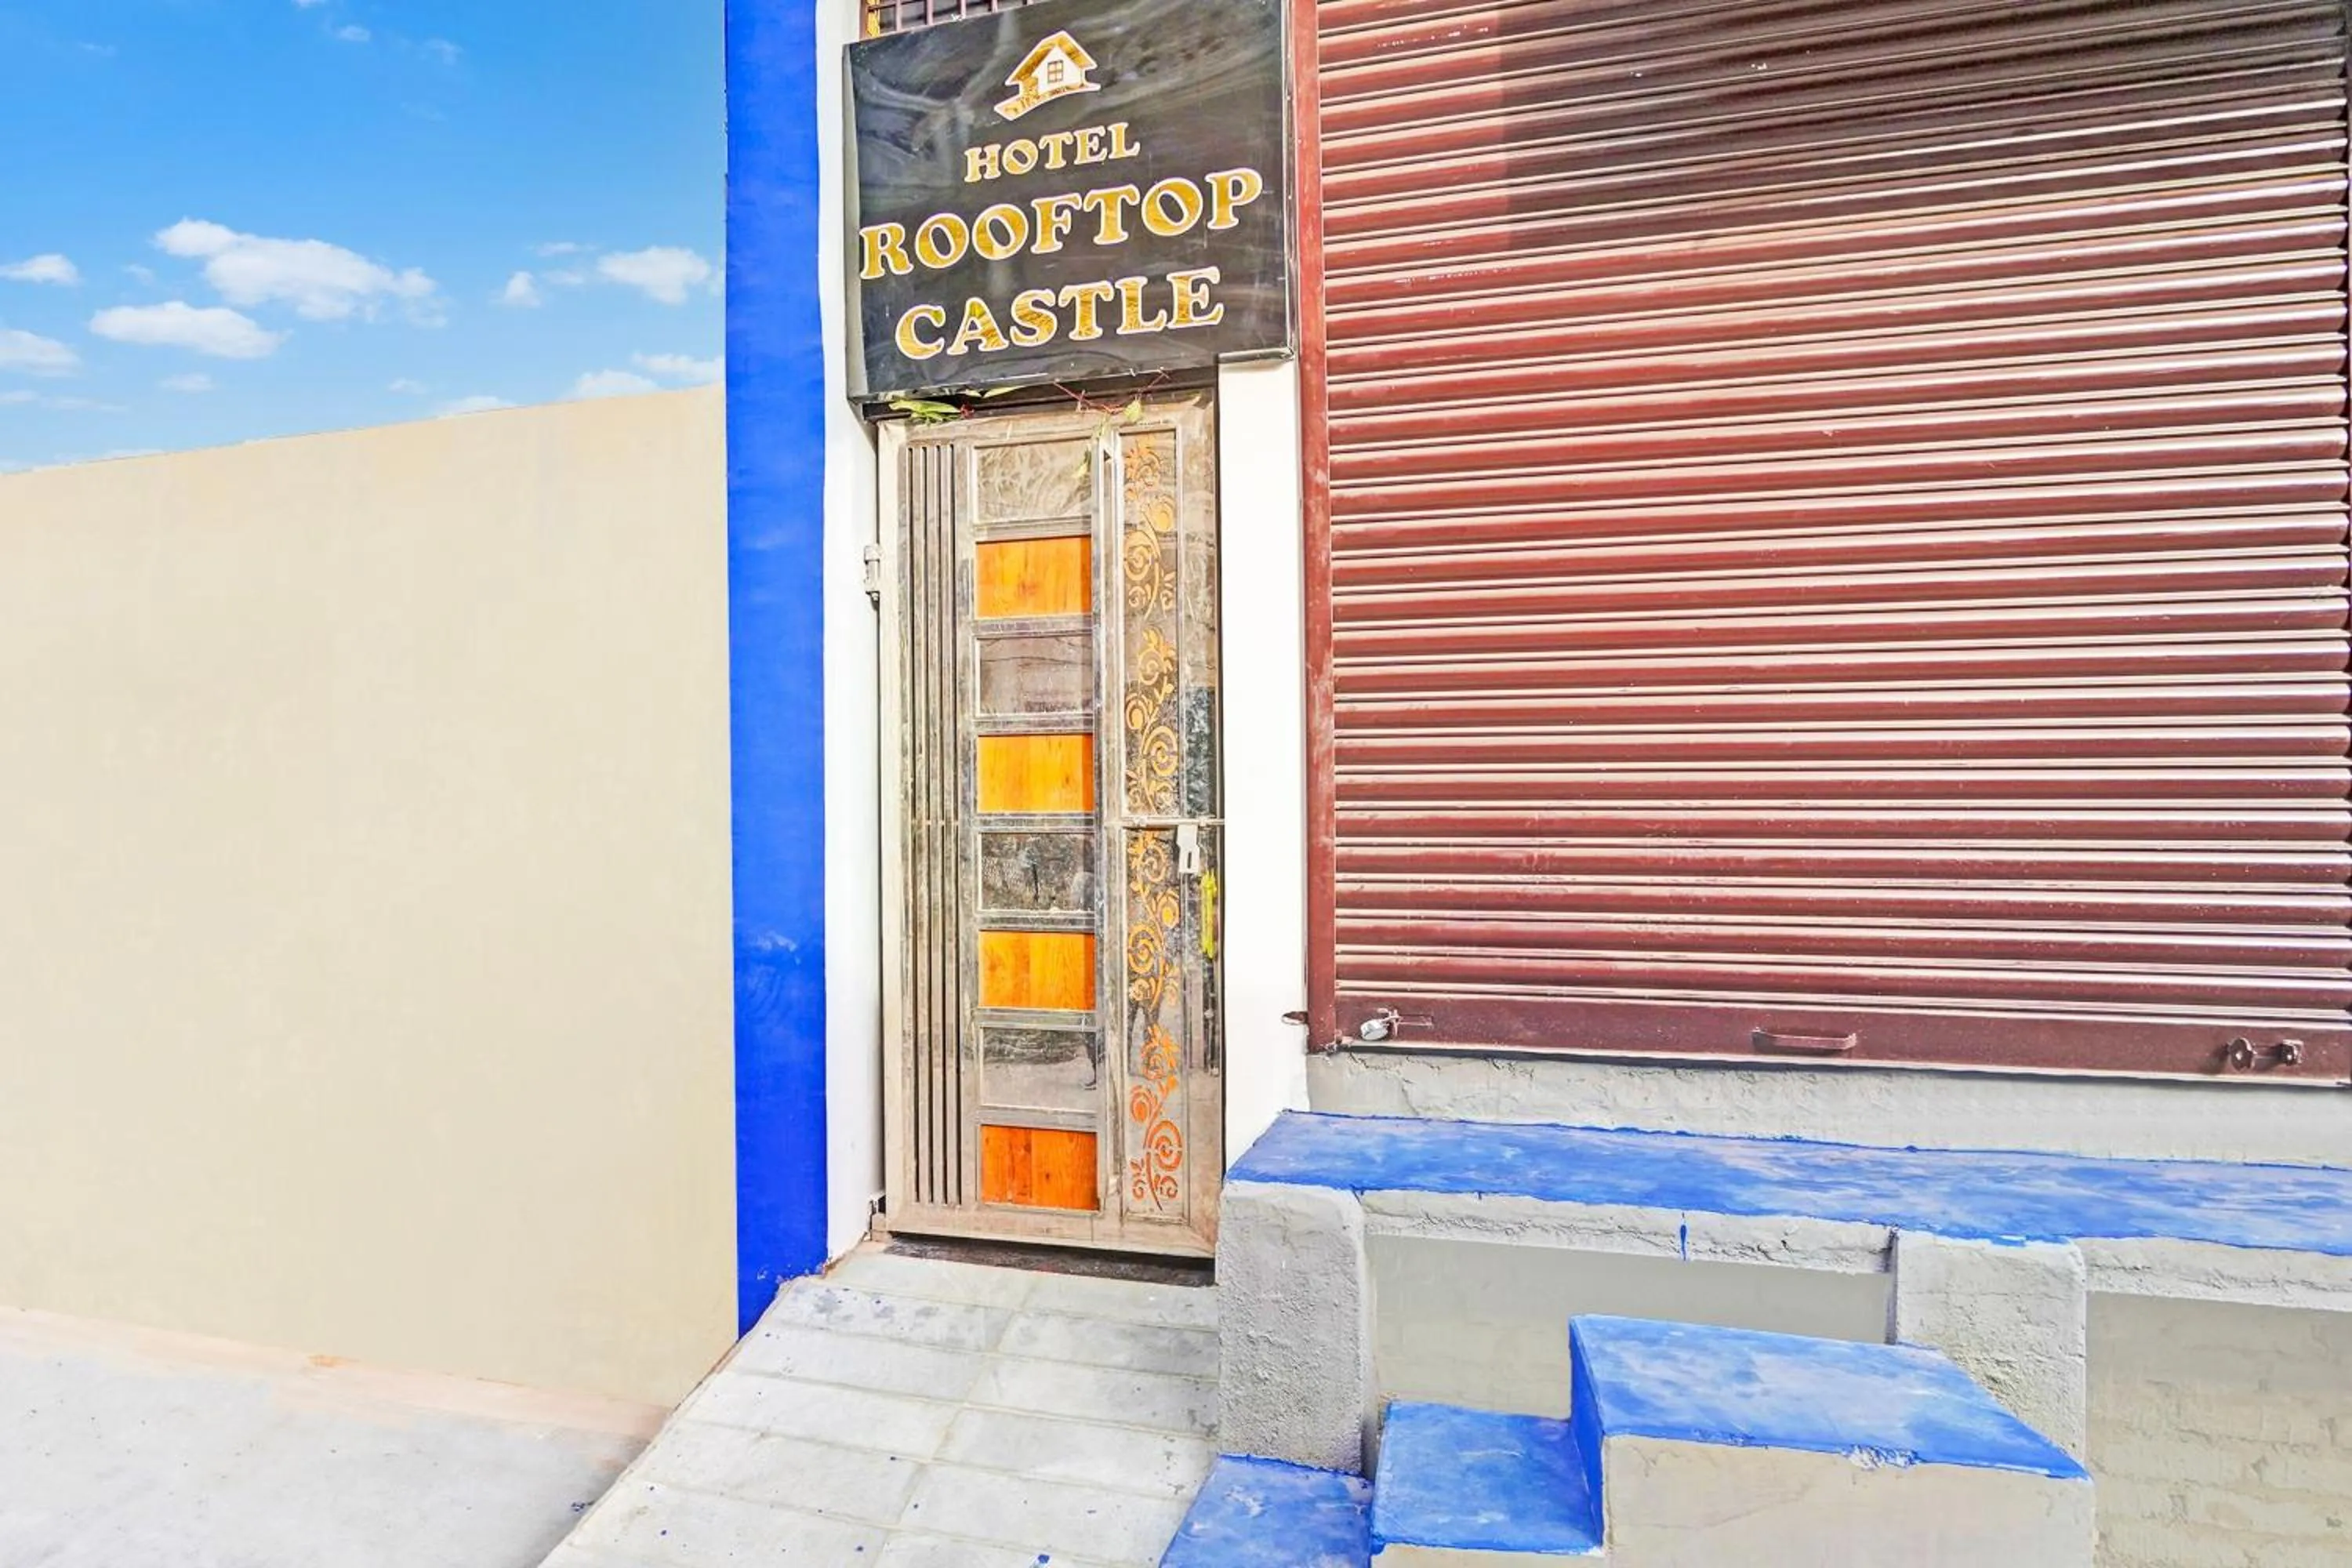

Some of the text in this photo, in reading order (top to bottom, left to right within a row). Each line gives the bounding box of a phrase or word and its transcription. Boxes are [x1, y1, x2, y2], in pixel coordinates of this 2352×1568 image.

[964, 122, 1141, 183] HOTEL
[859, 167, 1264, 280] ROOFTOP
[895, 267, 1225, 360] CASTLE
